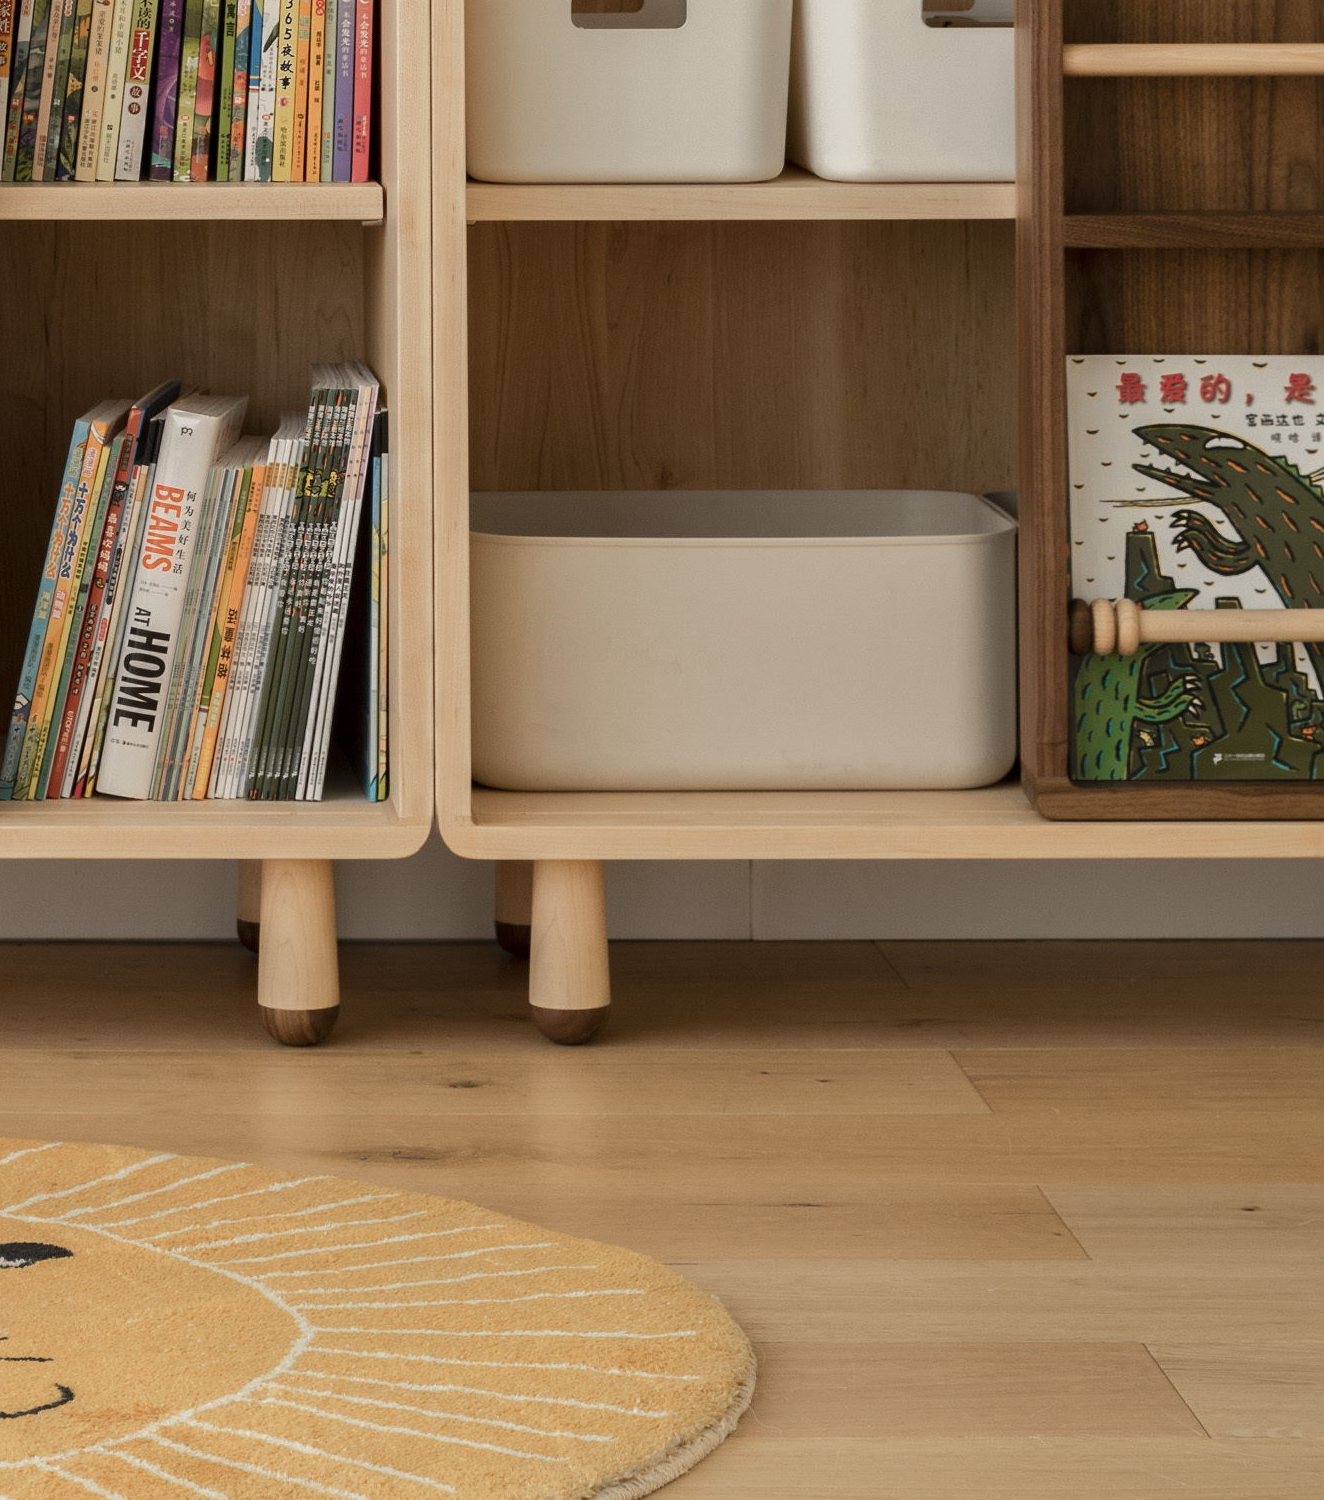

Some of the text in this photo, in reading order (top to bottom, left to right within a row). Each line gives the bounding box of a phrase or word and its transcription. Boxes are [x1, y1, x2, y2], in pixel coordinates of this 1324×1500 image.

[94, 10, 108, 56] 亲爱的笨笨猪
[278, 126, 288, 168] 哈尔滨出版社
[1245, 412, 1306, 428] 宫西达也
[45, 481, 76, 580] 十万个为什么
[60, 481, 89, 580] 十万个为什么
[97, 513, 118, 573] 最喜欢妈妈
[142, 484, 186, 573] BEAMS
[172, 490, 198, 575] 何为美好生活
[133, 606, 152, 628] AT
[306, 579, 320, 626] 我是霸王龙
[308, 577, 330, 666] 你看起来好像很好吃
[112, 626, 172, 733] HOME
[217, 607, 239, 680] 格林童话
